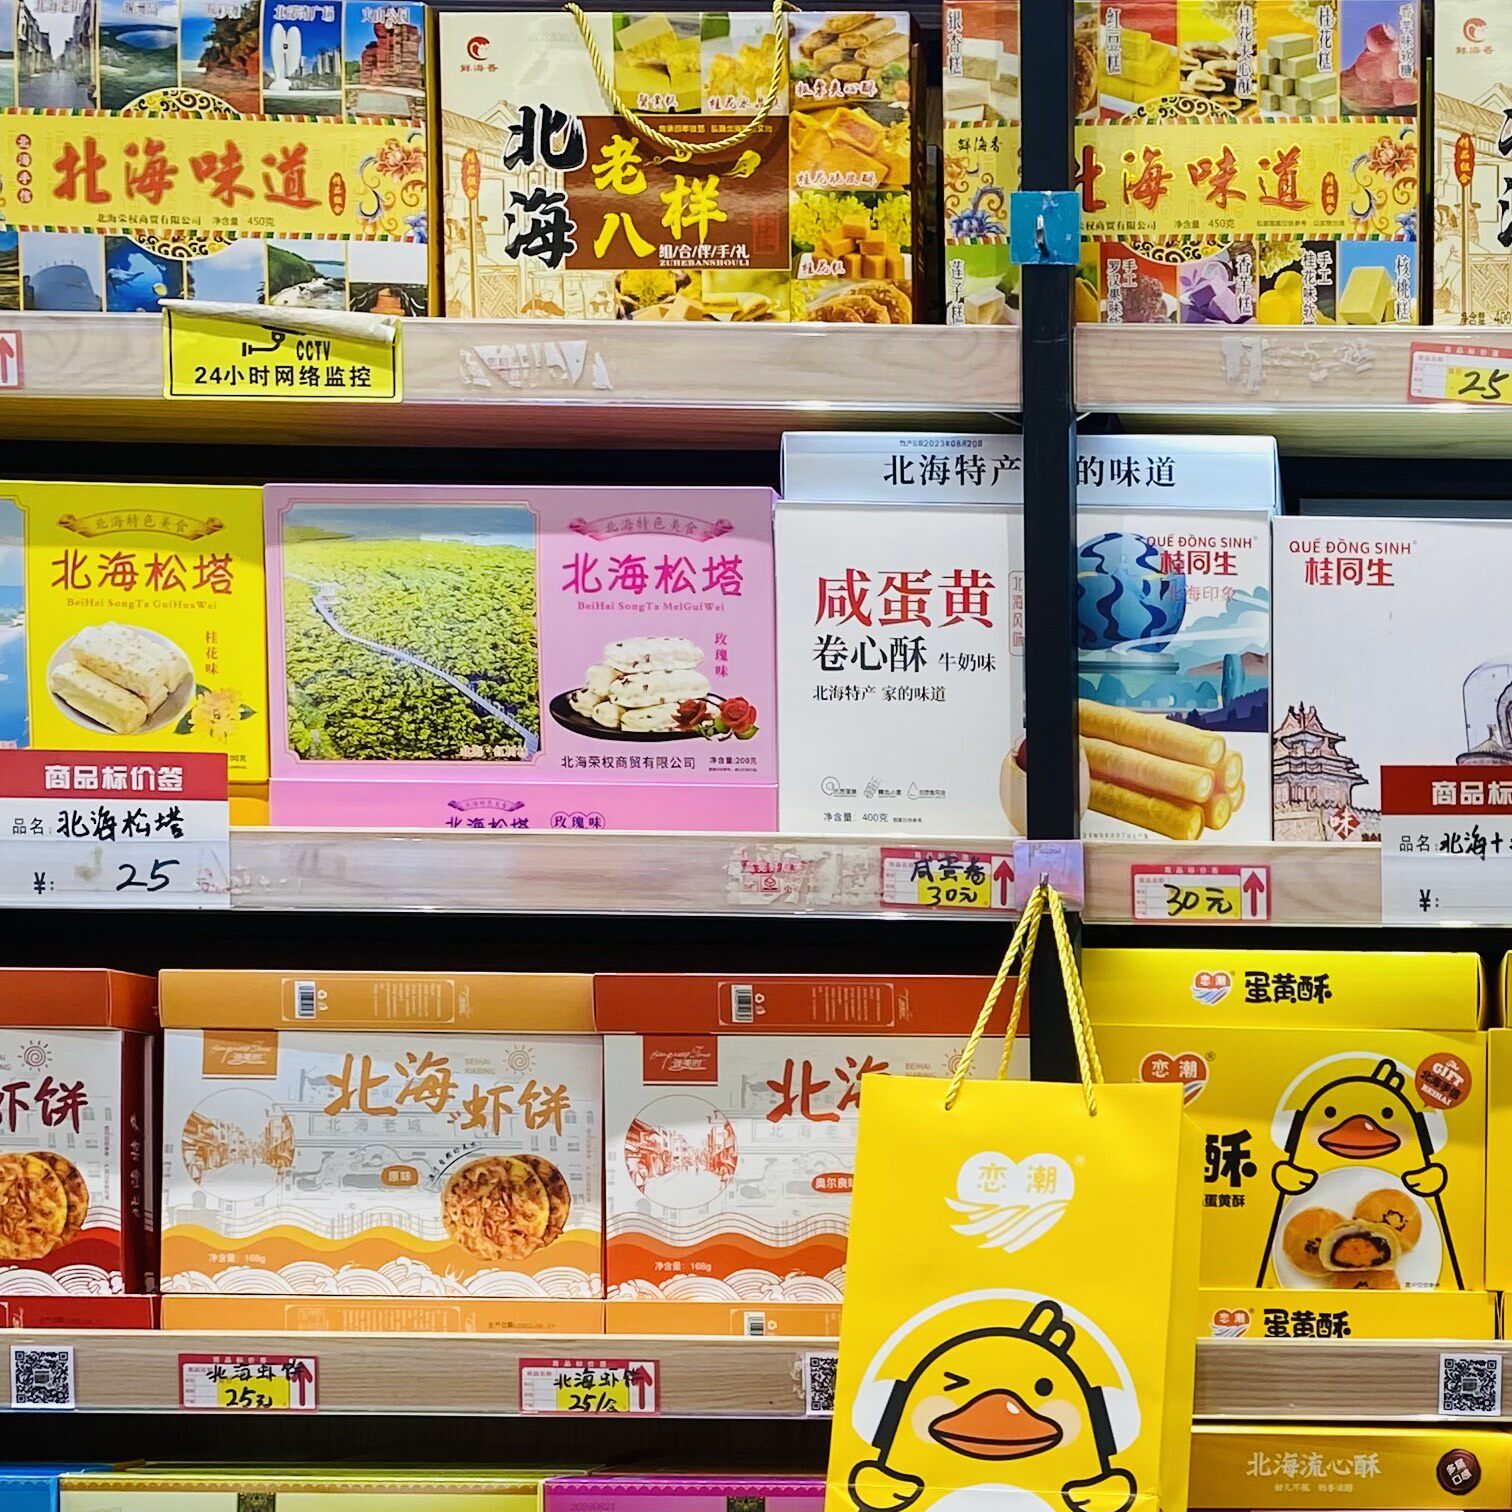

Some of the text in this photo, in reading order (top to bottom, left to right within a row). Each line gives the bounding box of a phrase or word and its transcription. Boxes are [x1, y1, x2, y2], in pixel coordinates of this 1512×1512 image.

[946, 8, 963, 76] 银杏糕
[1106, 7, 1121, 74] 红豆糕
[1237, 7, 1253, 97] 桂花夹心酥
[1318, 6, 1333, 72] 桂花糕
[53, 137, 322, 210] 北海味道
[503, 103, 587, 270] 北海
[296, 340, 331, 361] CCTV
[194, 365, 372, 389] 24小时网络监控
[1458, 371, 1503, 401] 25
[883, 454, 1022, 487] 北海特产
[1221, 536, 1252, 549] SINH
[1373, 541, 1411, 555] SINH
[51, 548, 235, 596] 北海松塔
[562, 552, 744, 598] 北海松塔
[1160, 551, 1238, 576] 桂同生
[1305, 557, 1395, 587] 桂同生
[814, 568, 997, 629] 咸蛋黄
[813, 634, 996, 674] 卷心酥 牛奶味
[812, 685, 946, 702] 北海特产 家的味道
[44, 765, 184, 791] 商品标价签
[561, 755, 696, 771] 北海荣权商贸有限公司
[56, 806, 185, 842] 北海松塔
[116, 859, 180, 892] 25
[927, 886, 978, 907] 30元
[1163, 883, 1234, 916] 30元
[1244, 971, 1333, 1004] 蛋黄酥
[1152, 1060, 1198, 1079] 恋潮
[324, 1052, 572, 1137] 北海虾饼
[977, 1162, 1058, 1195] 恋潮
[1264, 1309, 1352, 1338] 蛋黄酥
[1246, 1452, 1381, 1478] 北海流心酥
